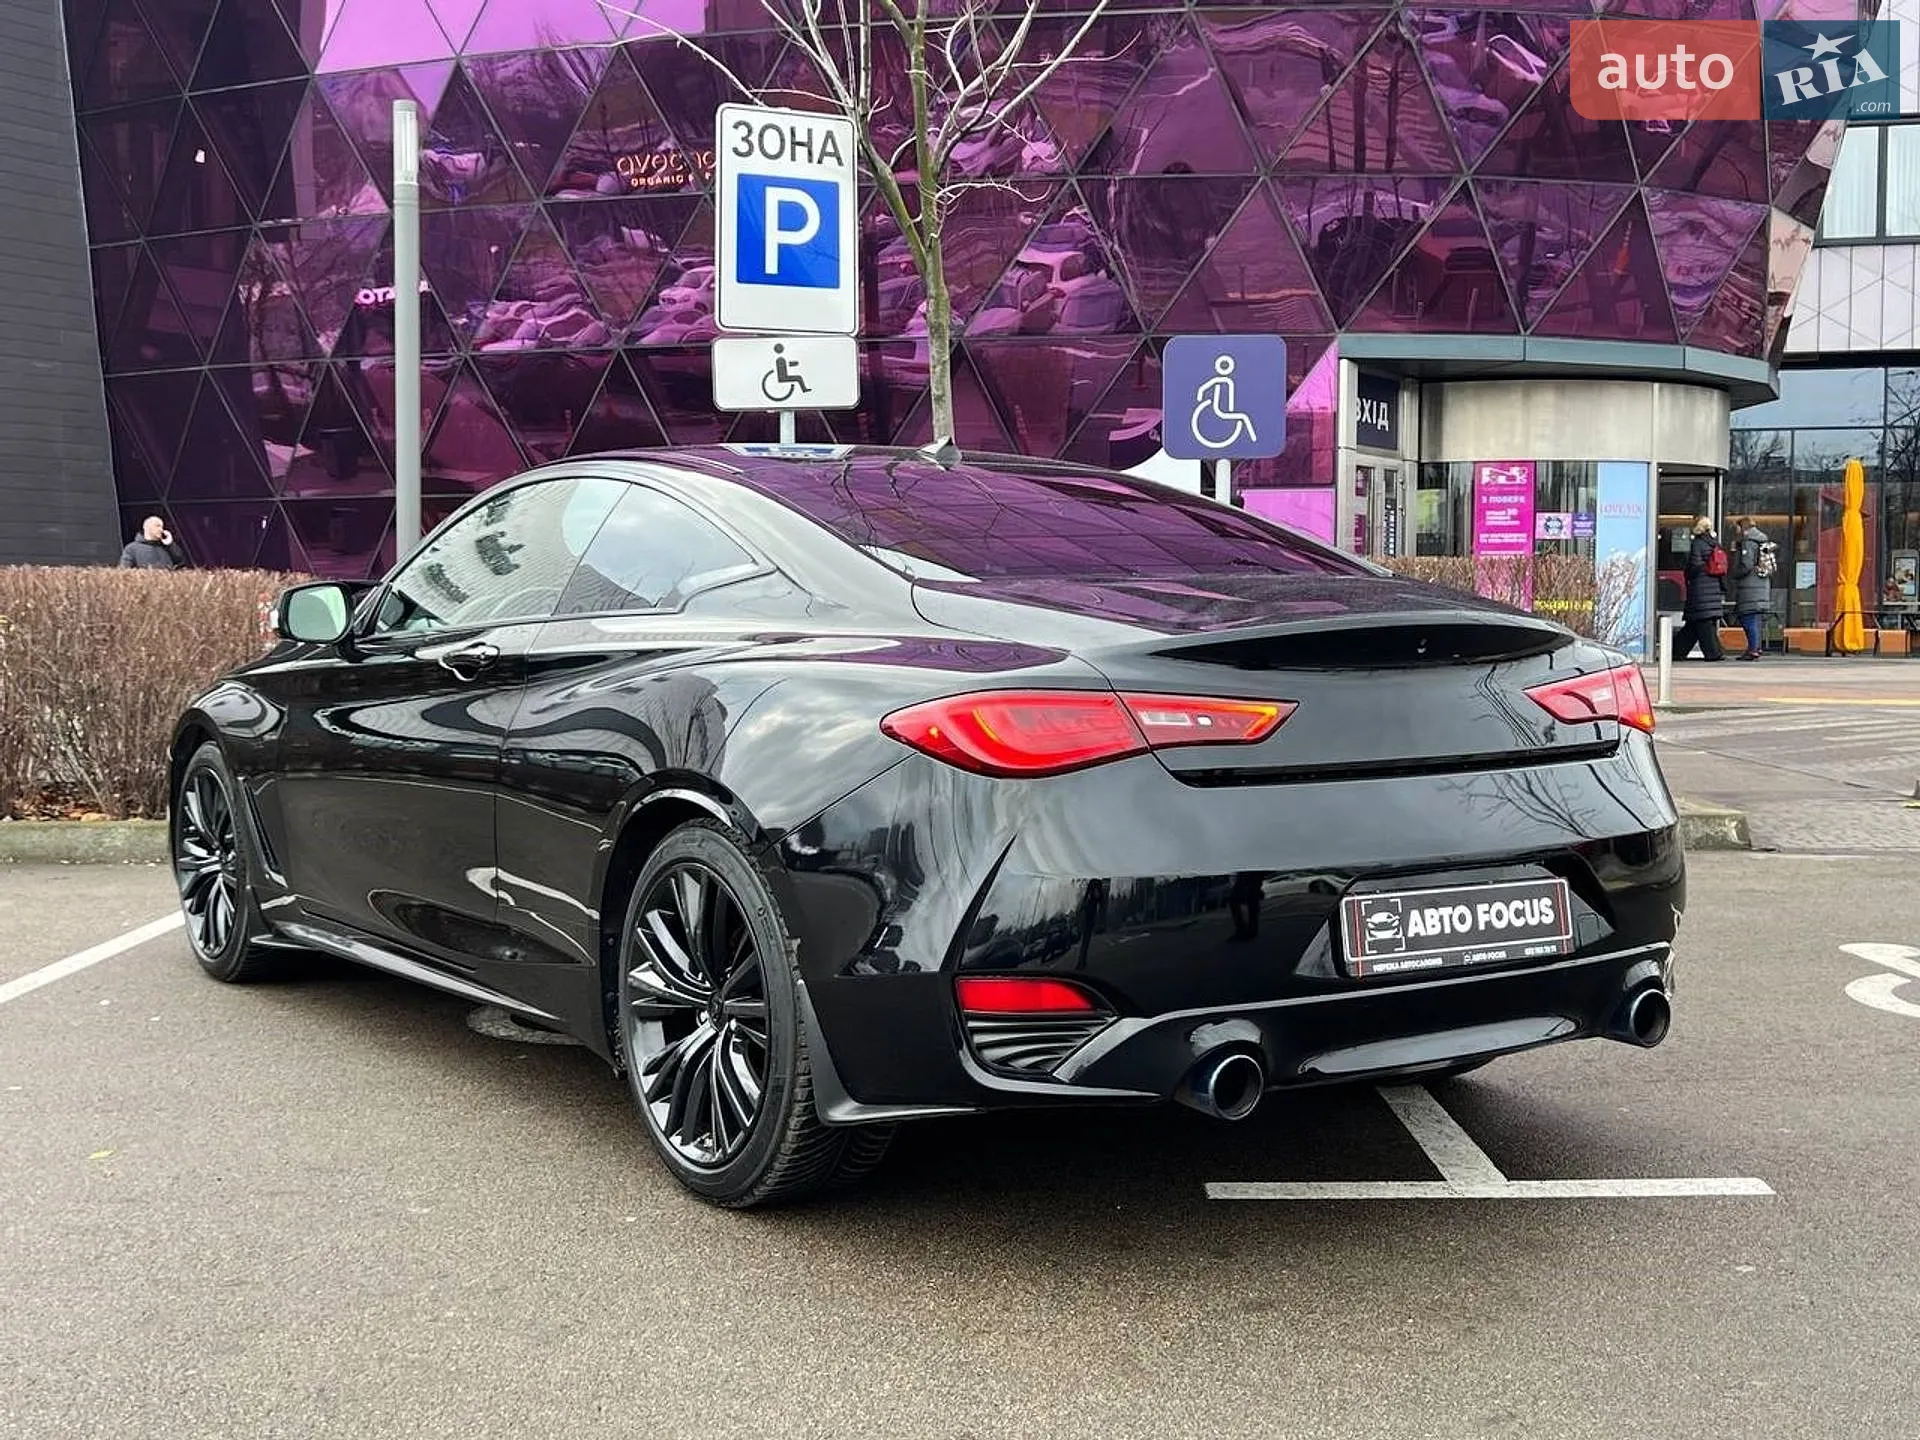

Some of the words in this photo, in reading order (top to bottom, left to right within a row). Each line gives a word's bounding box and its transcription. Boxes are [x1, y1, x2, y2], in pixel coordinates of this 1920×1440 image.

[732, 120, 844, 167] ЗОНА
[765, 186, 821, 275] P
[1407, 904, 1473, 938] АВТО
[1476, 897, 1555, 931] FOCUS
